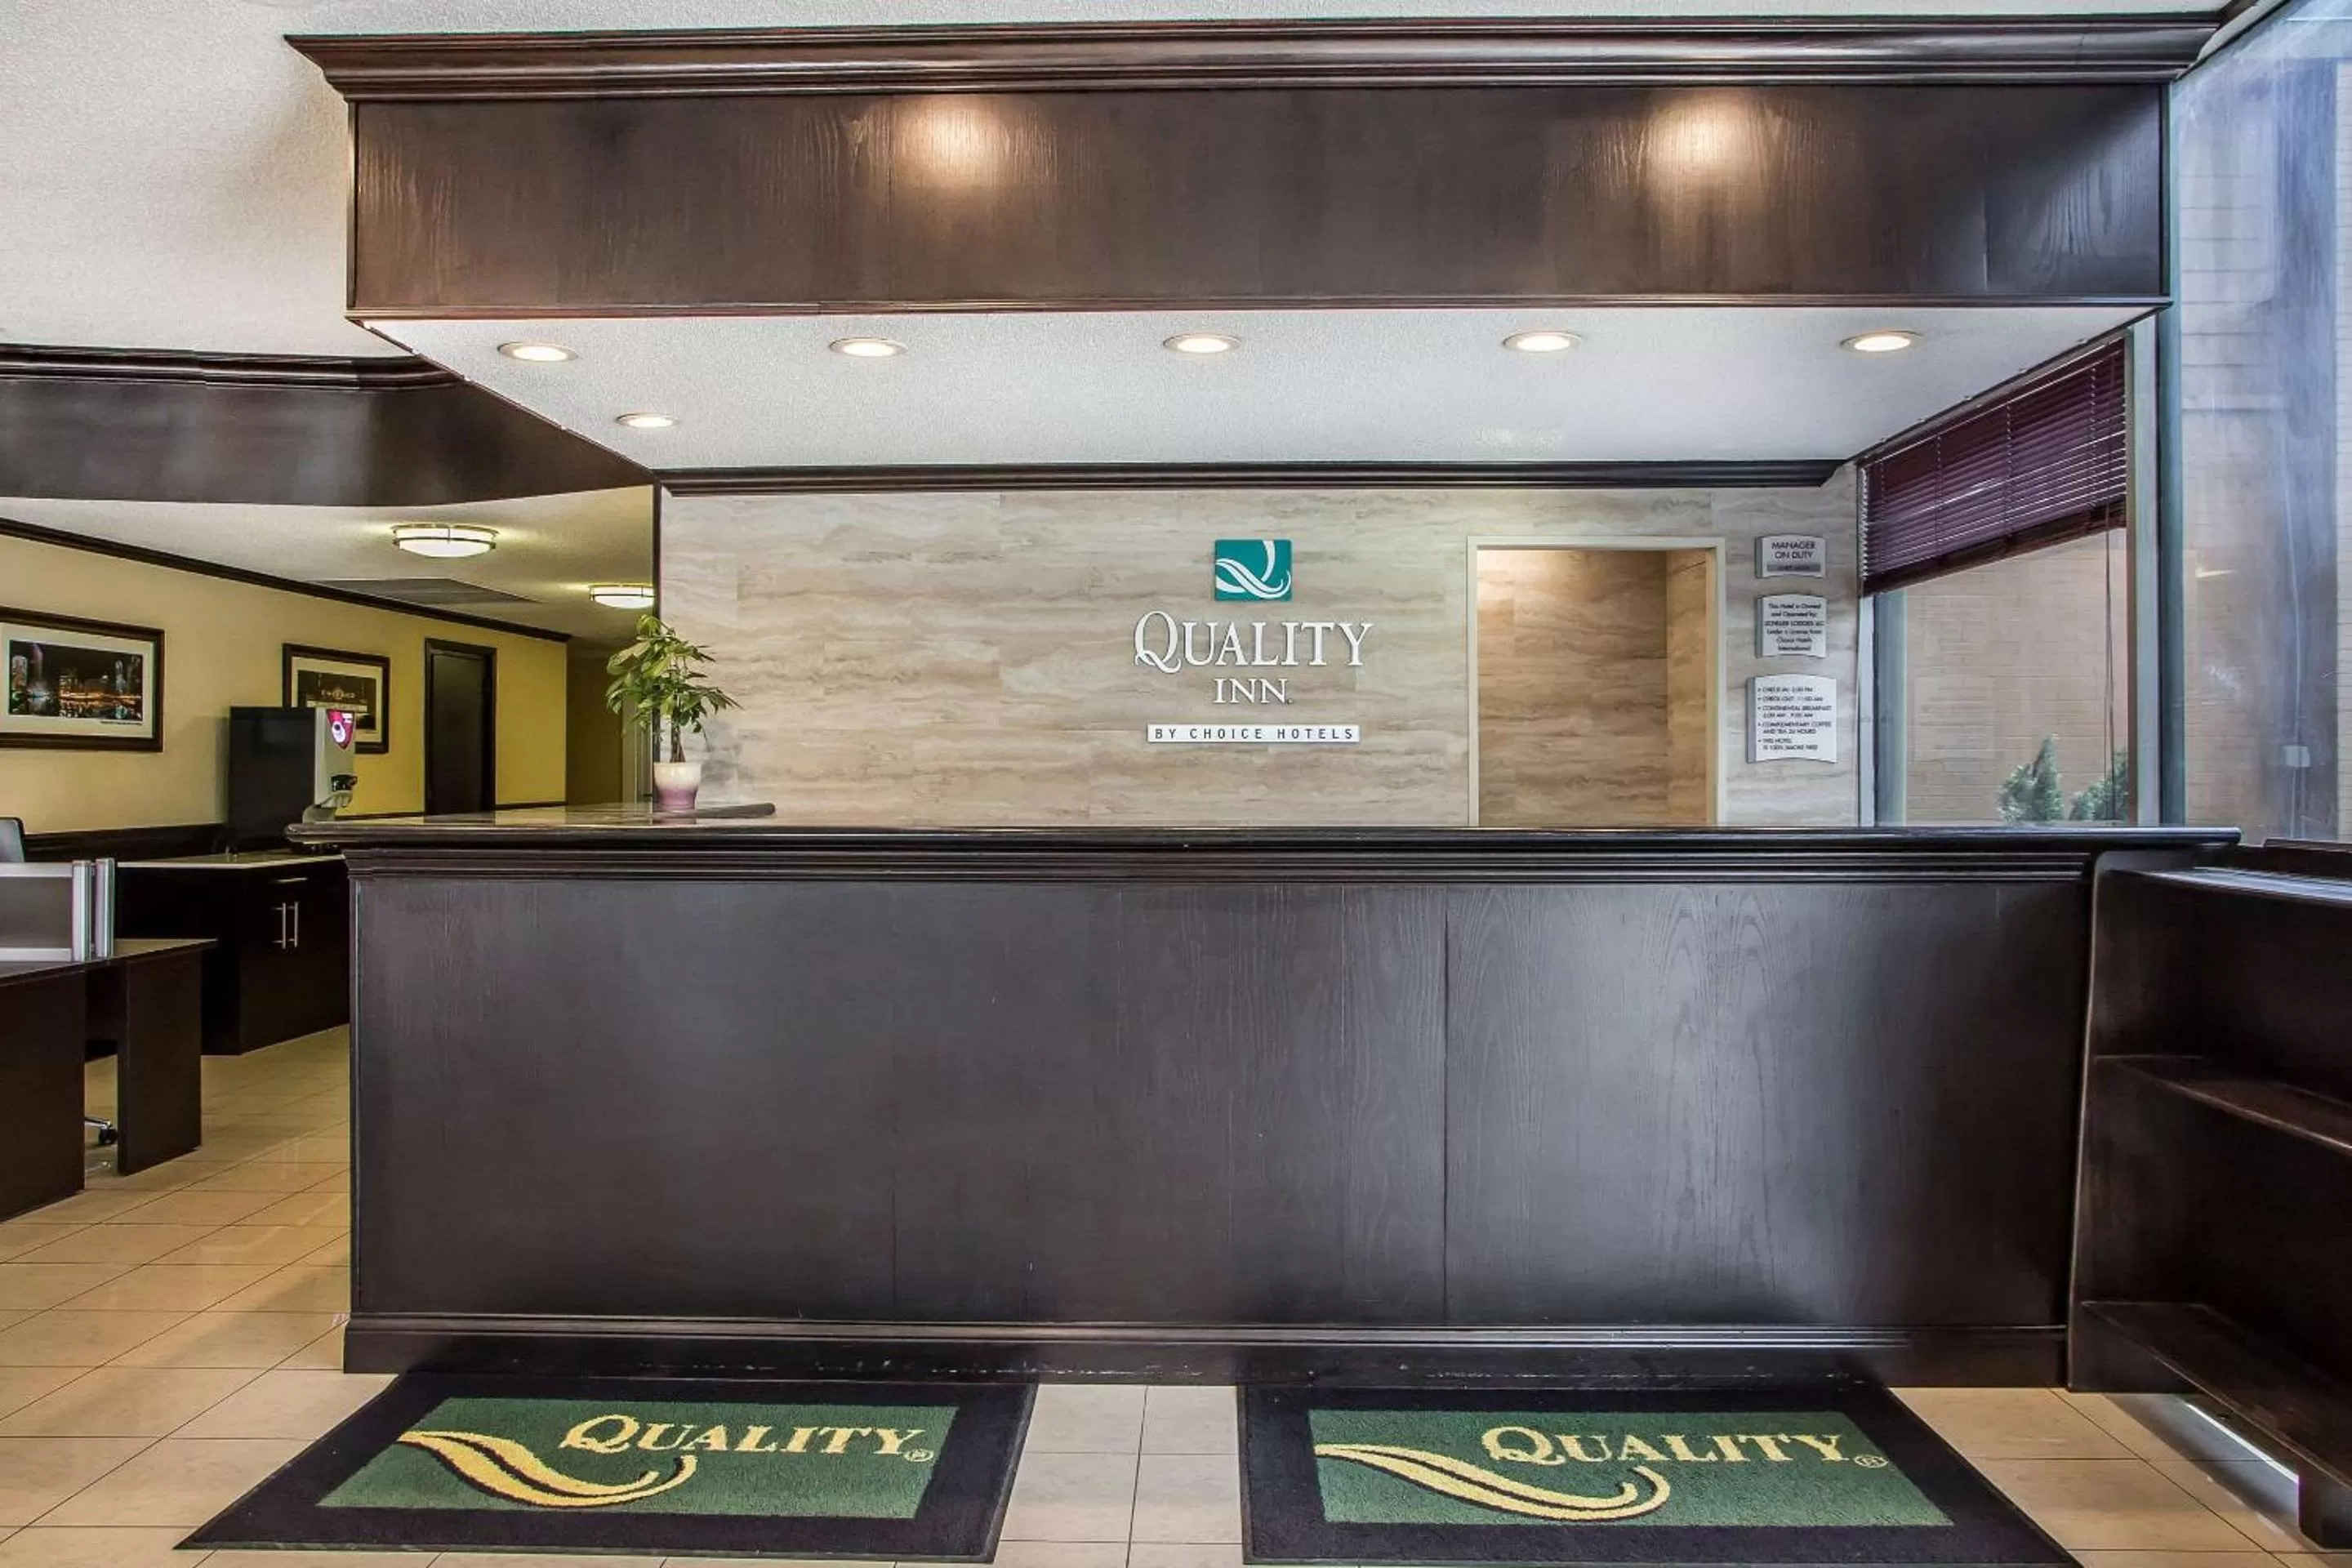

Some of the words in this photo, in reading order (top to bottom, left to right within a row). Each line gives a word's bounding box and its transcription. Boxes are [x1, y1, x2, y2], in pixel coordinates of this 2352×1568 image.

[1771, 541, 1816, 550] MANAGER
[1134, 610, 1374, 674] QUALITY
[1213, 678, 1288, 704] INN
[1155, 728, 1177, 739] BY
[1189, 728, 1262, 739] CHOICE
[1277, 728, 1353, 739] HOTELS
[558, 1413, 926, 1454] QUALITY
[1481, 1425, 1851, 1465] QUALITY
